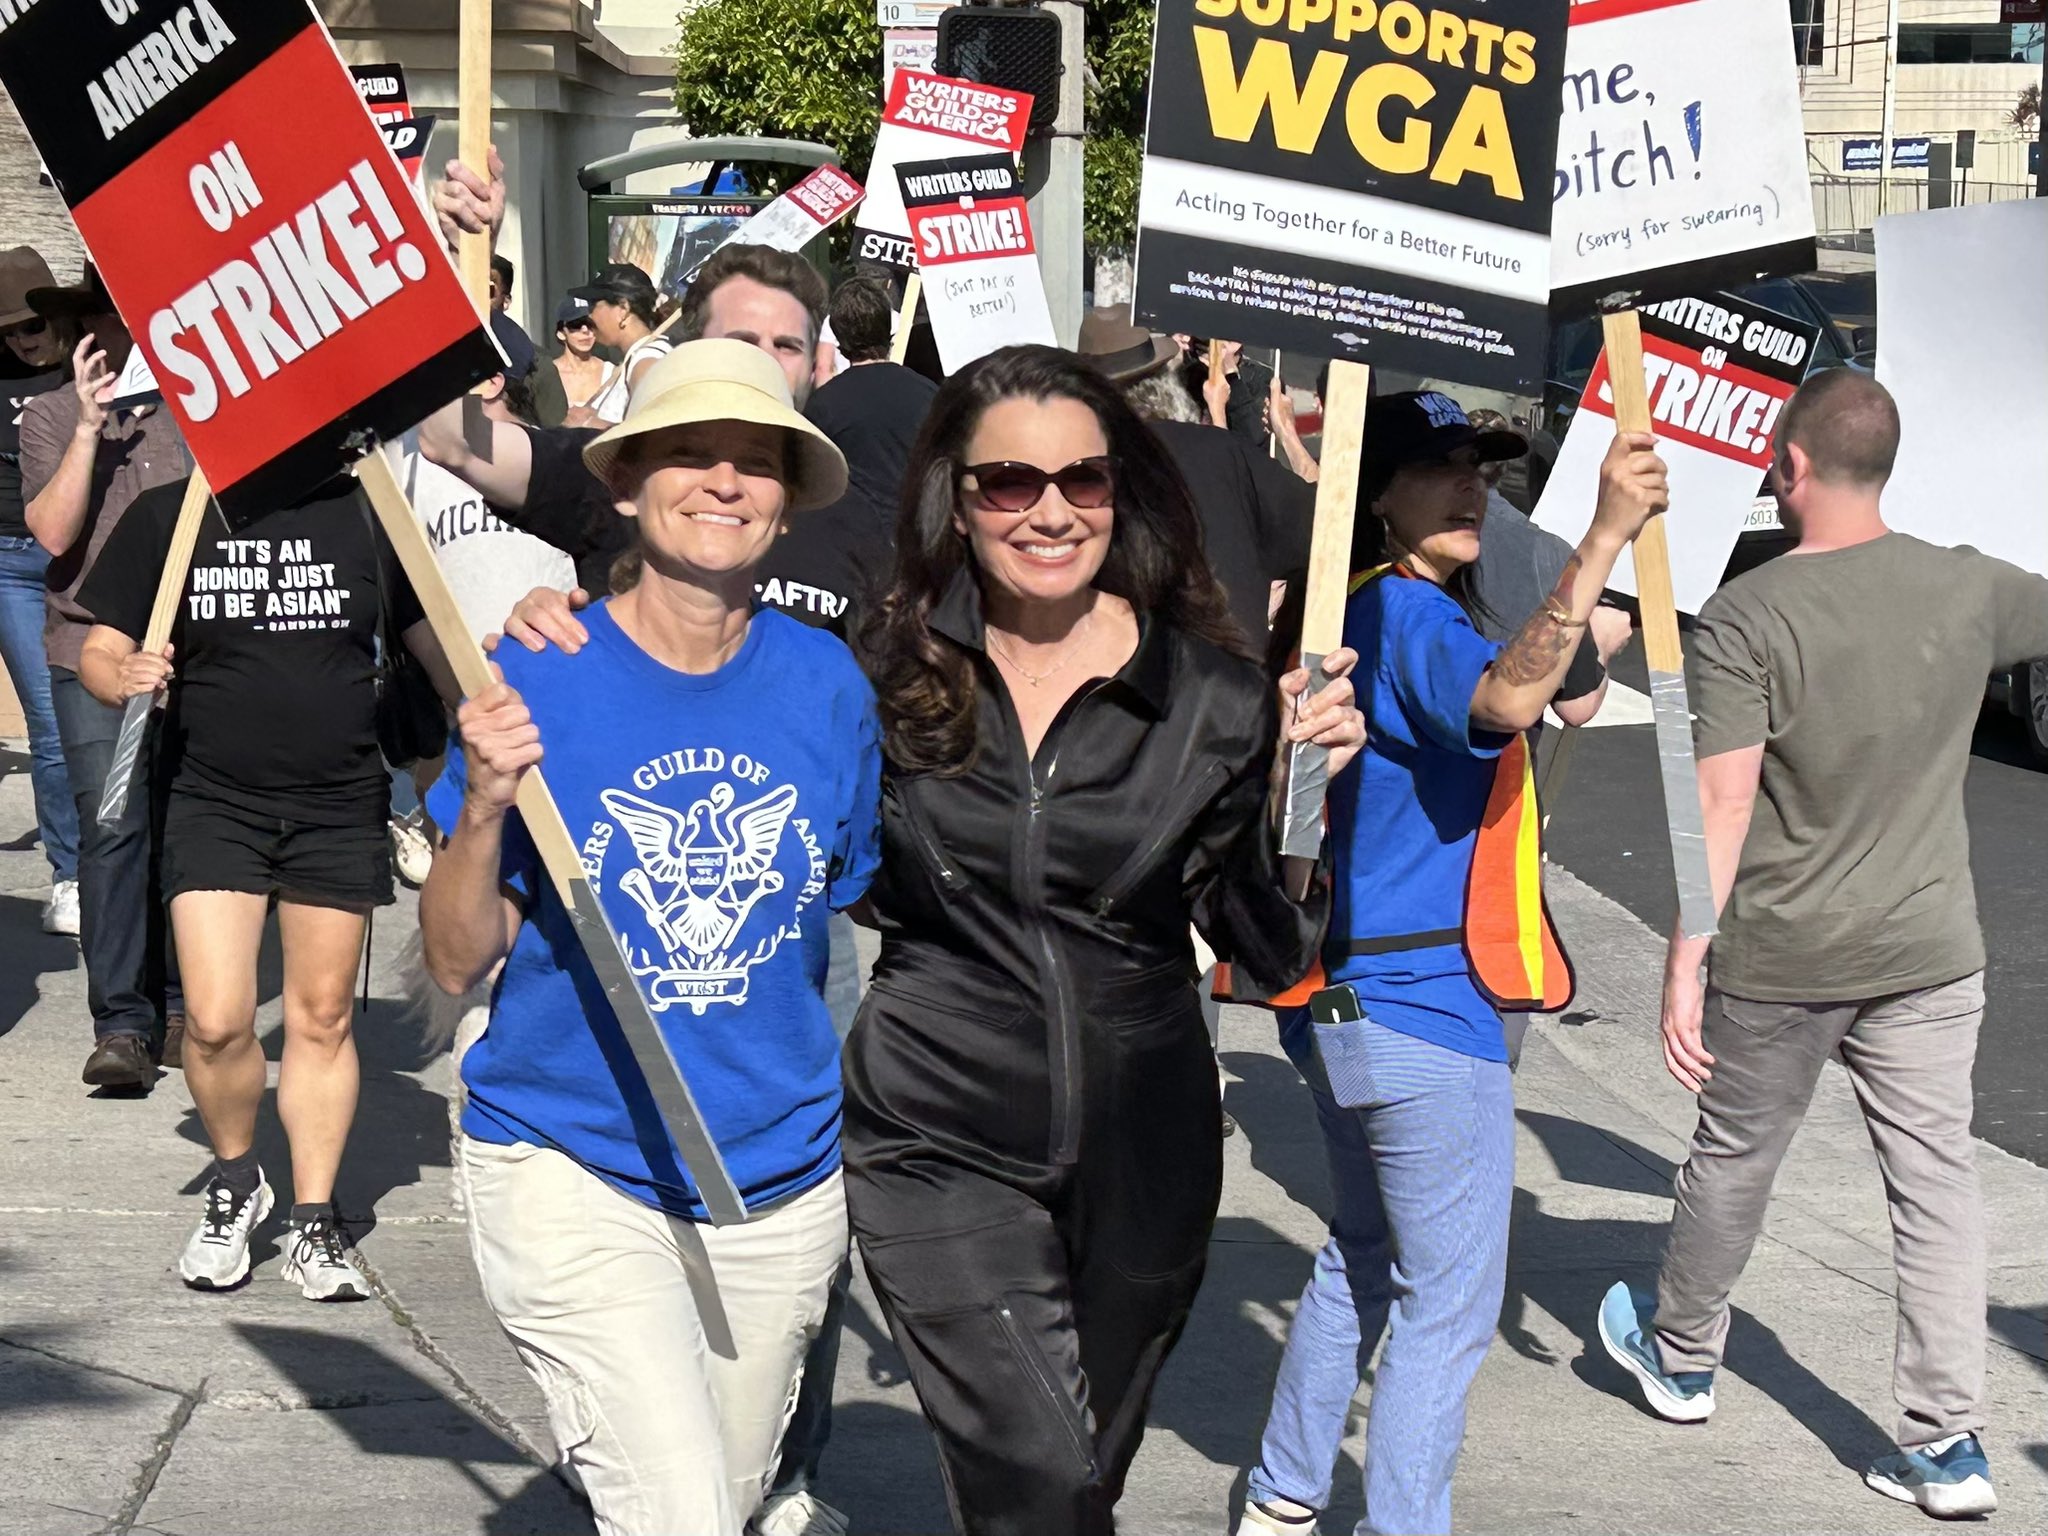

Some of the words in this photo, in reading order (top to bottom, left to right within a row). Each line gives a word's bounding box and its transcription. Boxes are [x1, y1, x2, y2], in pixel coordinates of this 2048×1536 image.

[883, 5, 900, 21] 10
[86, 0, 237, 141] AMERICA
[904, 92, 983, 120] GUILD
[907, 77, 1017, 113] WRITERS
[1192, 25, 1525, 201] WGA
[894, 105, 1012, 144] AMERICA
[188, 140, 264, 233] ON
[905, 170, 973, 198] WRITERS
[973, 168, 1012, 191] GUILD
[918, 207, 1027, 259] STRIKE!
[1175, 188, 1247, 222] Acting
[1251, 201, 1346, 236] Together
[1352, 217, 1379, 243] for
[1384, 230, 1394, 245] a
[1400, 230, 1457, 260] Better
[1462, 244, 1522, 274] Future
[1641, 219, 1671, 240] for
[148, 158, 427, 423] STRIKE!
[1701, 345, 1728, 371] ON
[1742, 321, 1807, 367] GUILD
[1598, 351, 1784, 455] TRIKE!
[278, 538, 313, 563] AN
[193, 566, 270, 593] HONOR
[277, 563, 336, 589] JUST
[188, 594, 217, 621] TO
[224, 592, 257, 619] BE
[632, 747, 726, 791] GUILD
[730, 753, 771, 786] OF
[673, 979, 730, 997] WEST
